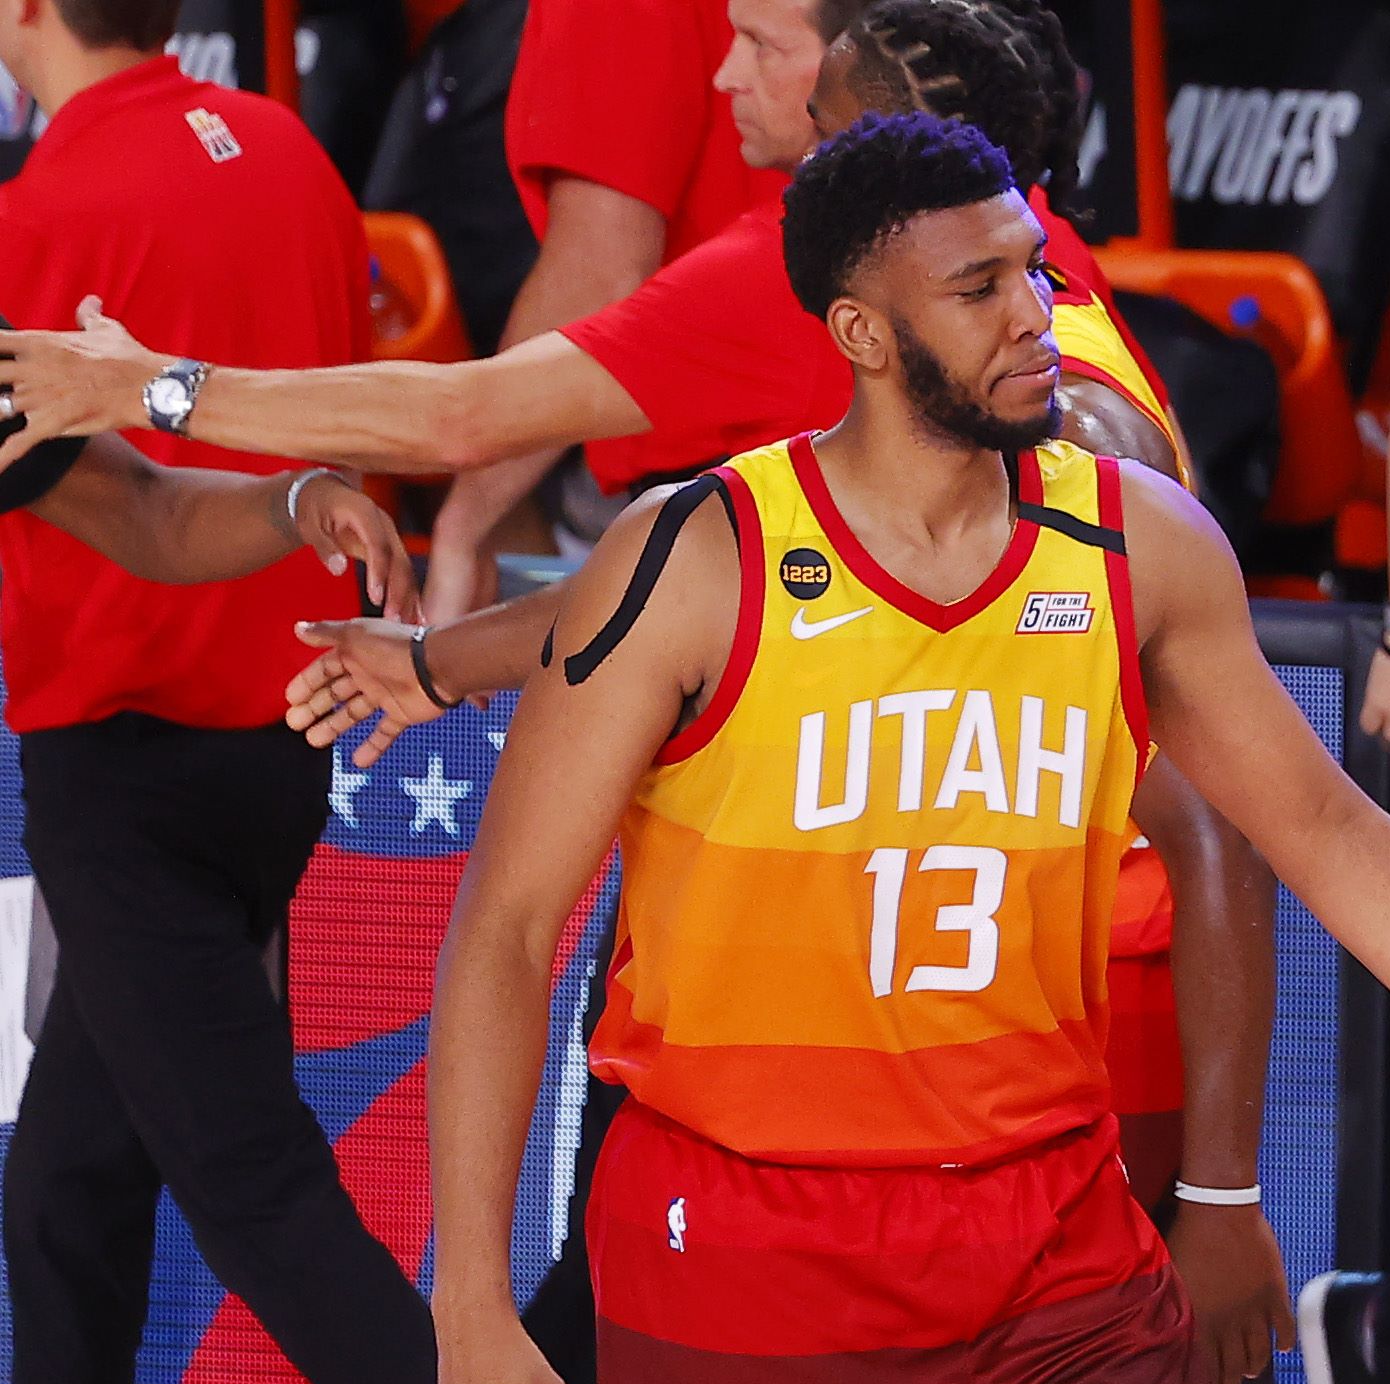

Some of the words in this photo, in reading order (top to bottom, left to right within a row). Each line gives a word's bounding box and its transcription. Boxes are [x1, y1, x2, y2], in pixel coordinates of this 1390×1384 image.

[782, 564, 828, 583] 1223
[1024, 598, 1044, 628] 5
[1045, 613, 1087, 628] FIGHT
[792, 688, 1088, 832] UTAH
[863, 845, 1008, 998] 13
